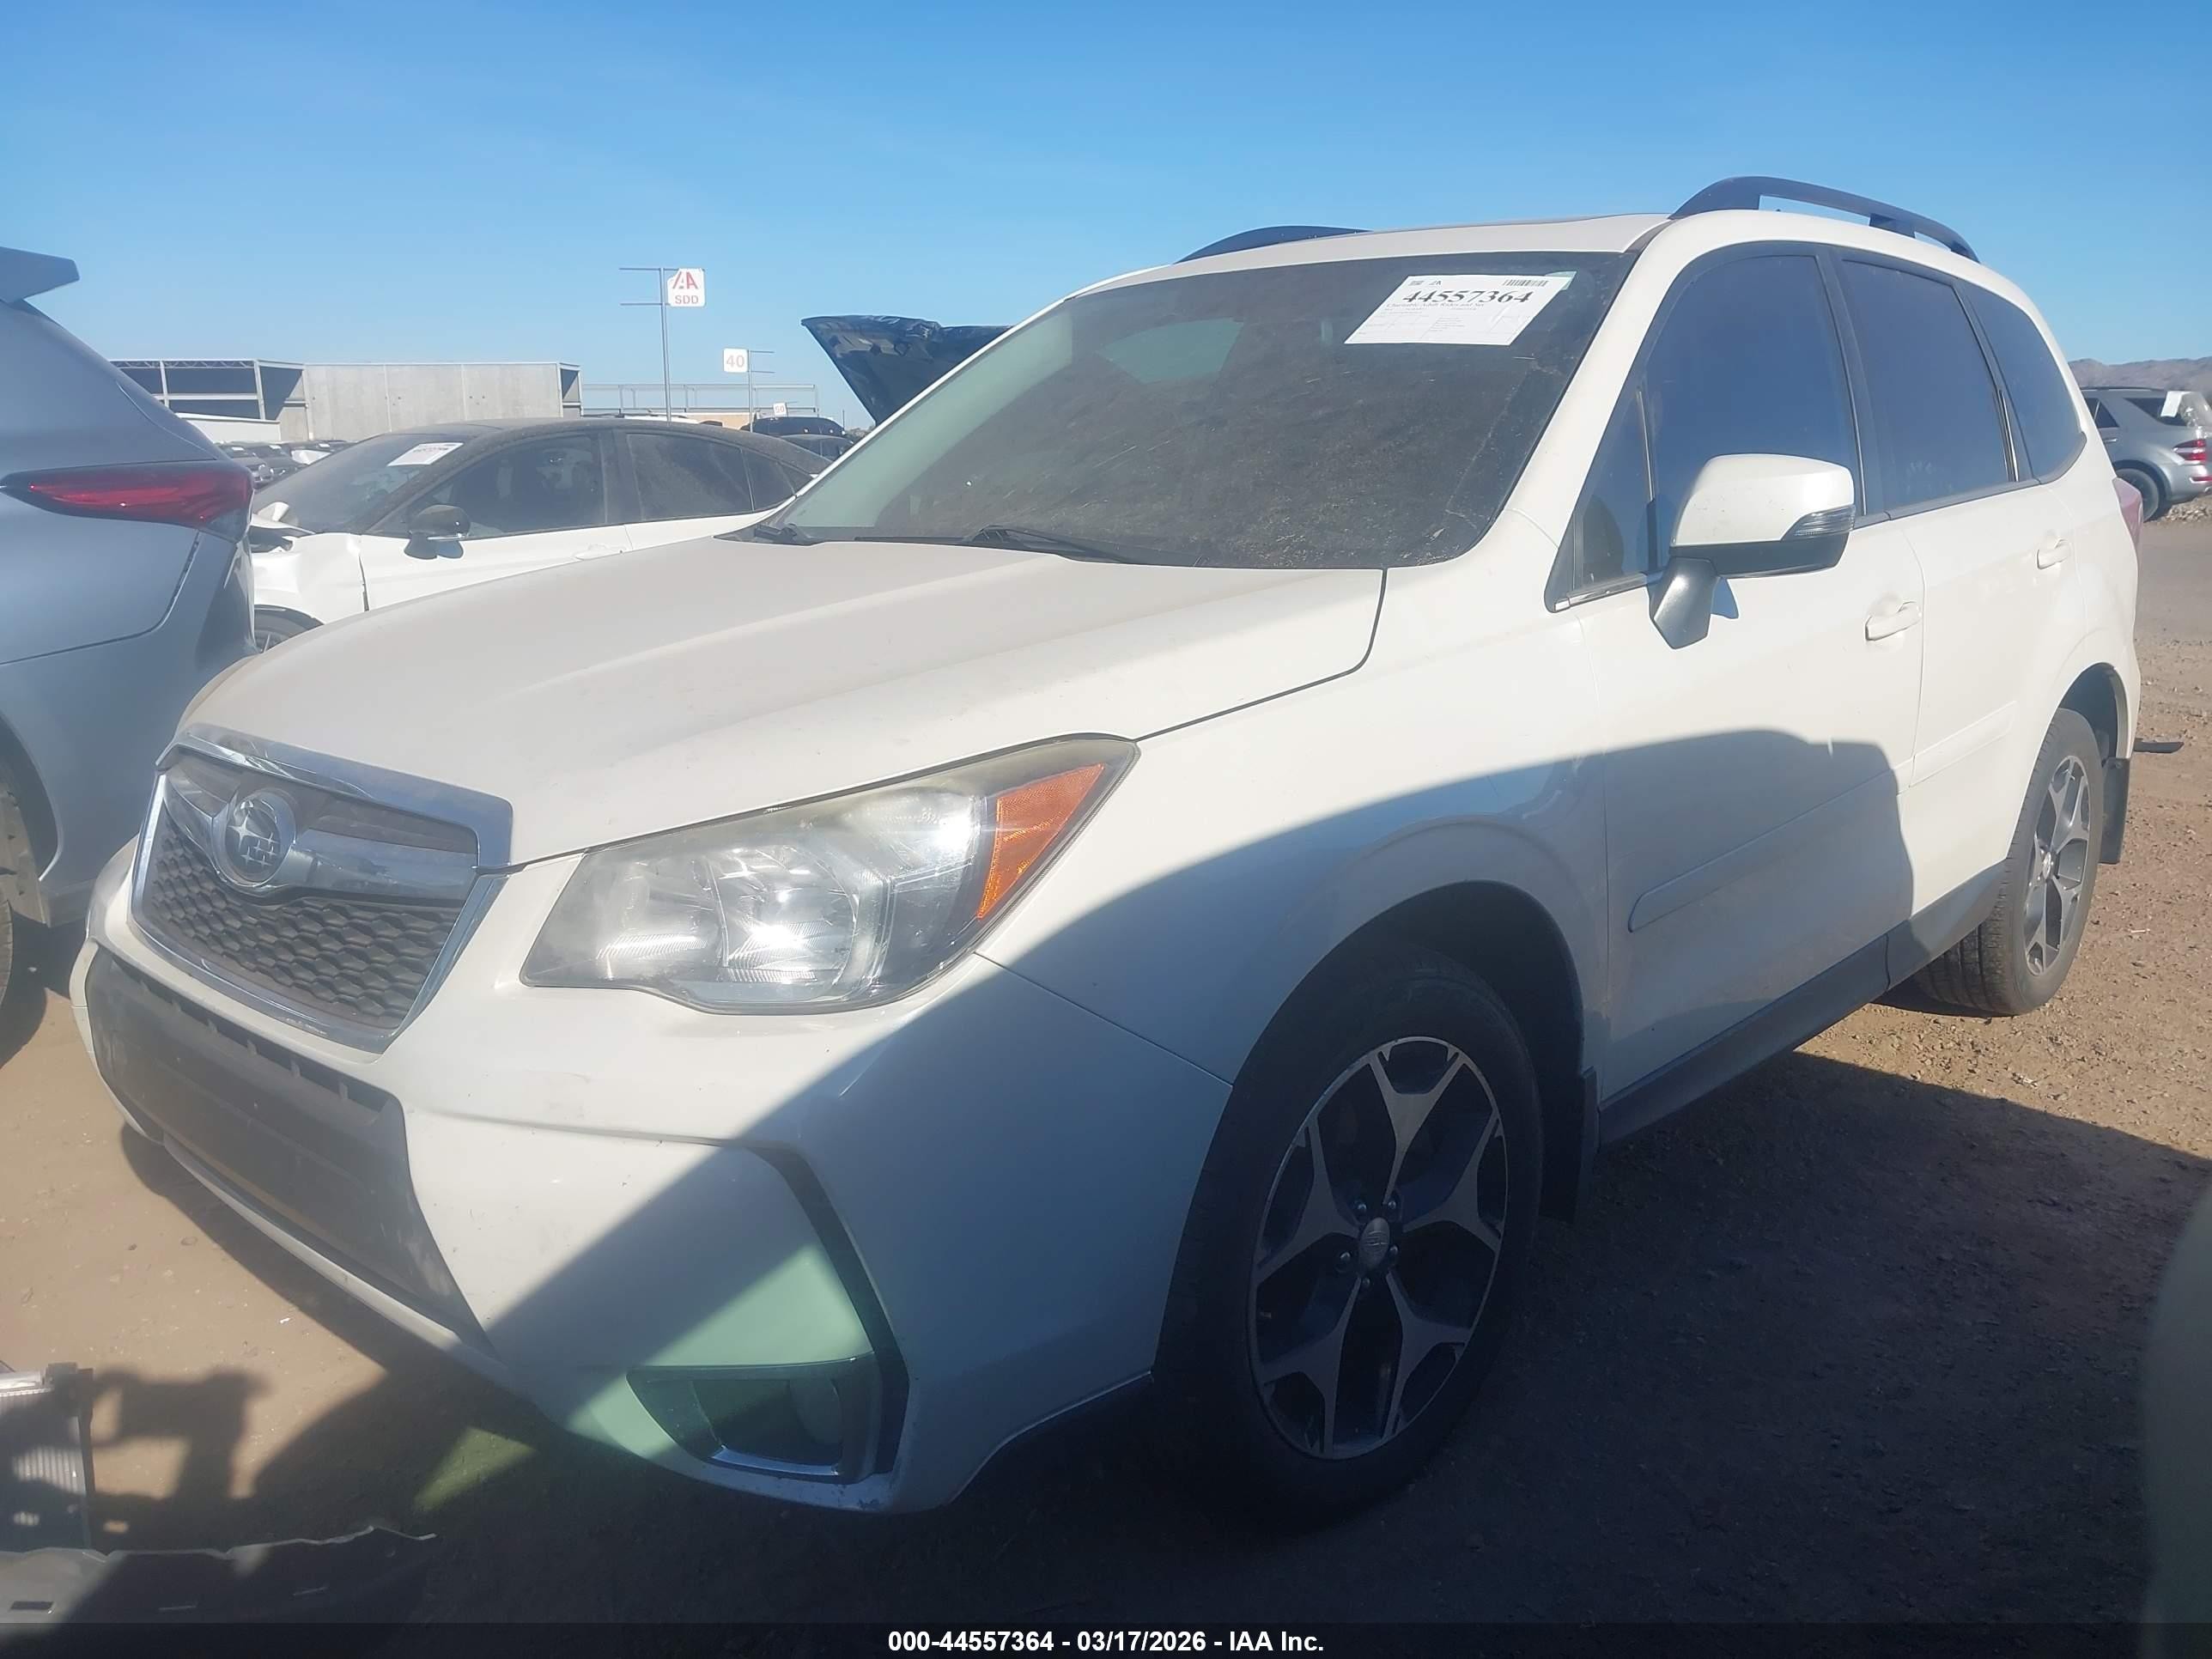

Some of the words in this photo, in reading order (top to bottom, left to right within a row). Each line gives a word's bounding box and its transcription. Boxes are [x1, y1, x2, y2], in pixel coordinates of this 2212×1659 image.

[674, 295, 699, 305] SDD
[1402, 289, 1534, 303] 44557364
[726, 355, 745, 368] 40
